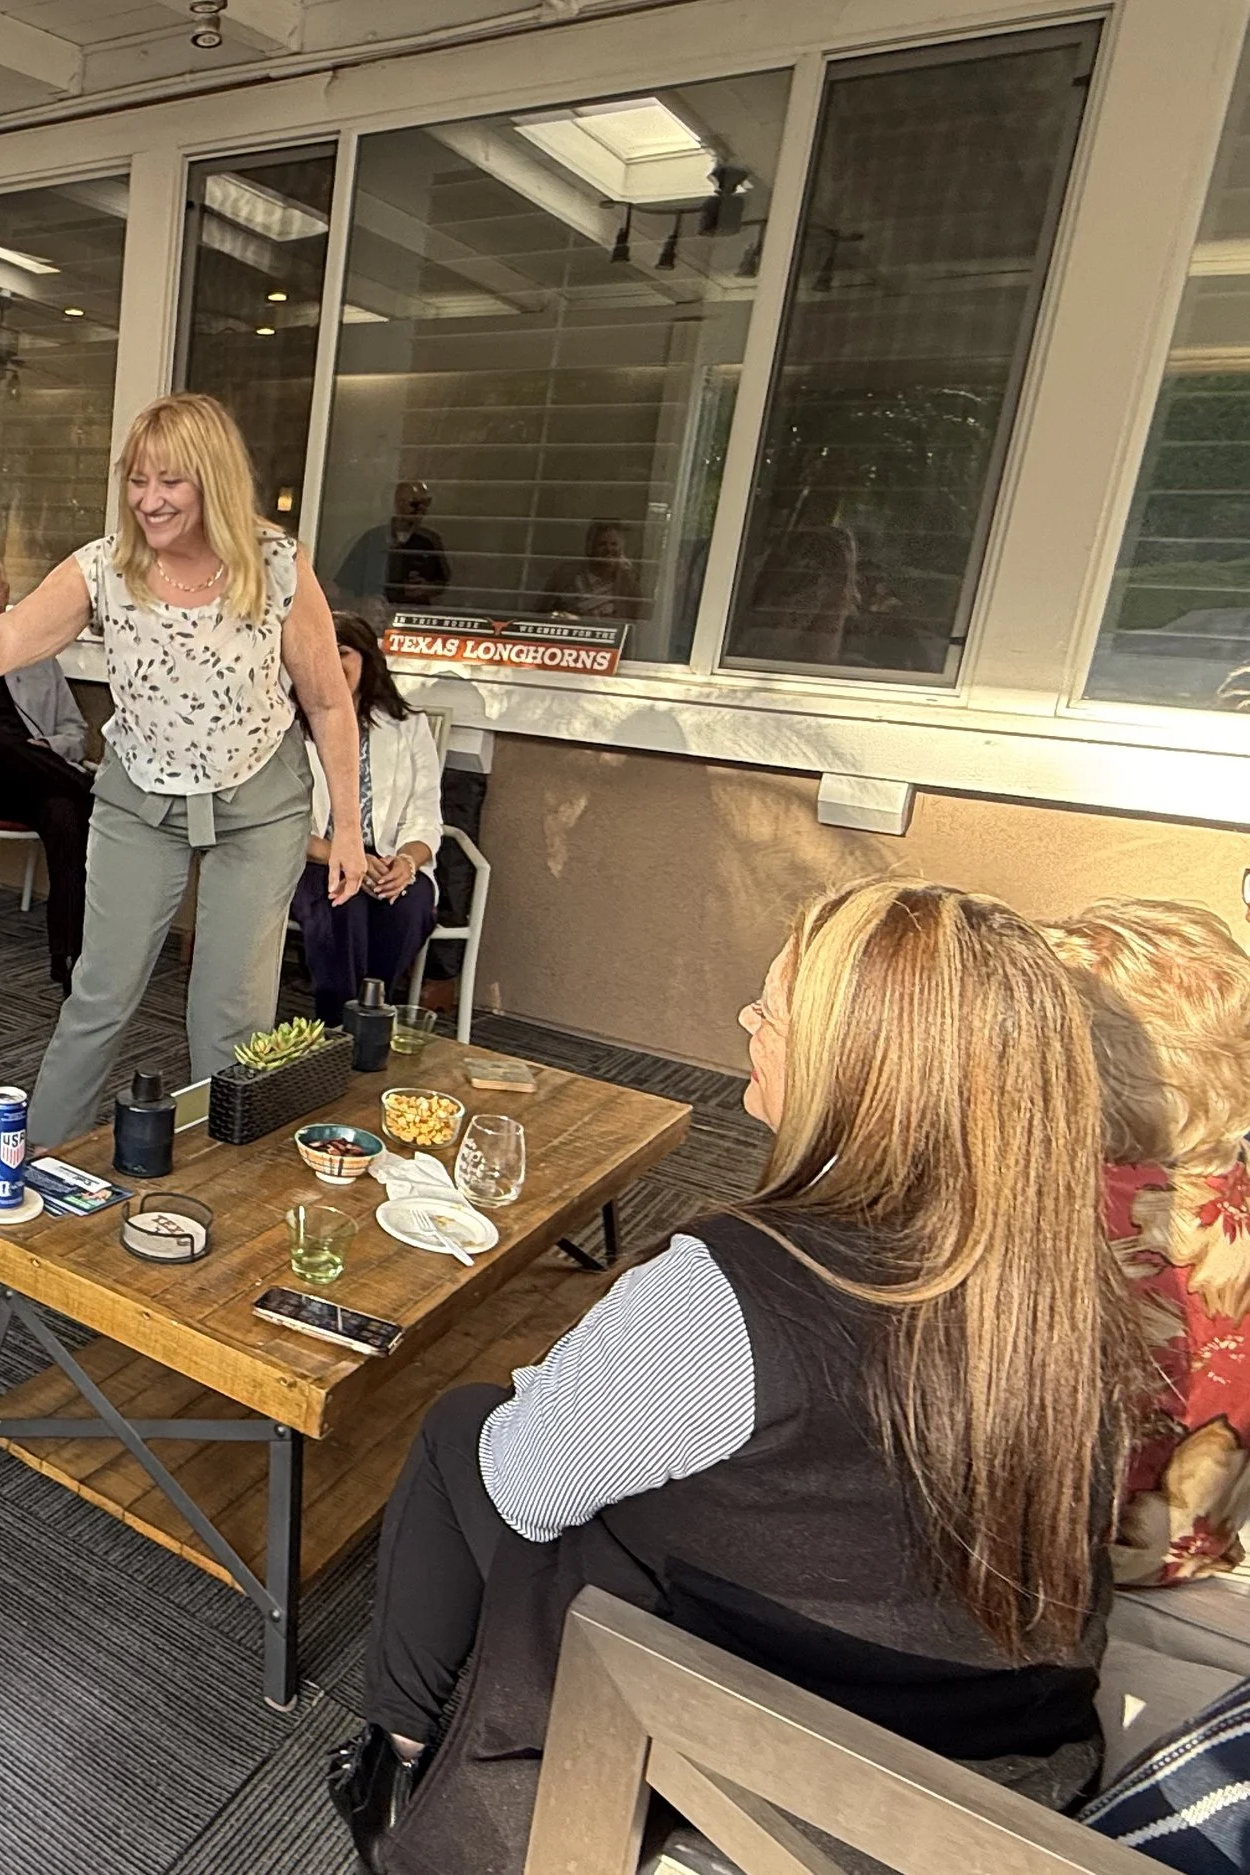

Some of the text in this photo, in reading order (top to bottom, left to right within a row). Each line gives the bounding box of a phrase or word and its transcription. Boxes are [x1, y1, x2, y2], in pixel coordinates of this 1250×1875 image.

[412, 617, 438, 626] THIS
[443, 620, 480, 629] HOUSE
[519, 625, 534, 633] WE
[572, 629, 592, 638] FOR
[595, 631, 616, 640] THE
[389, 634, 611, 671] TEXAS LONGHORNS
